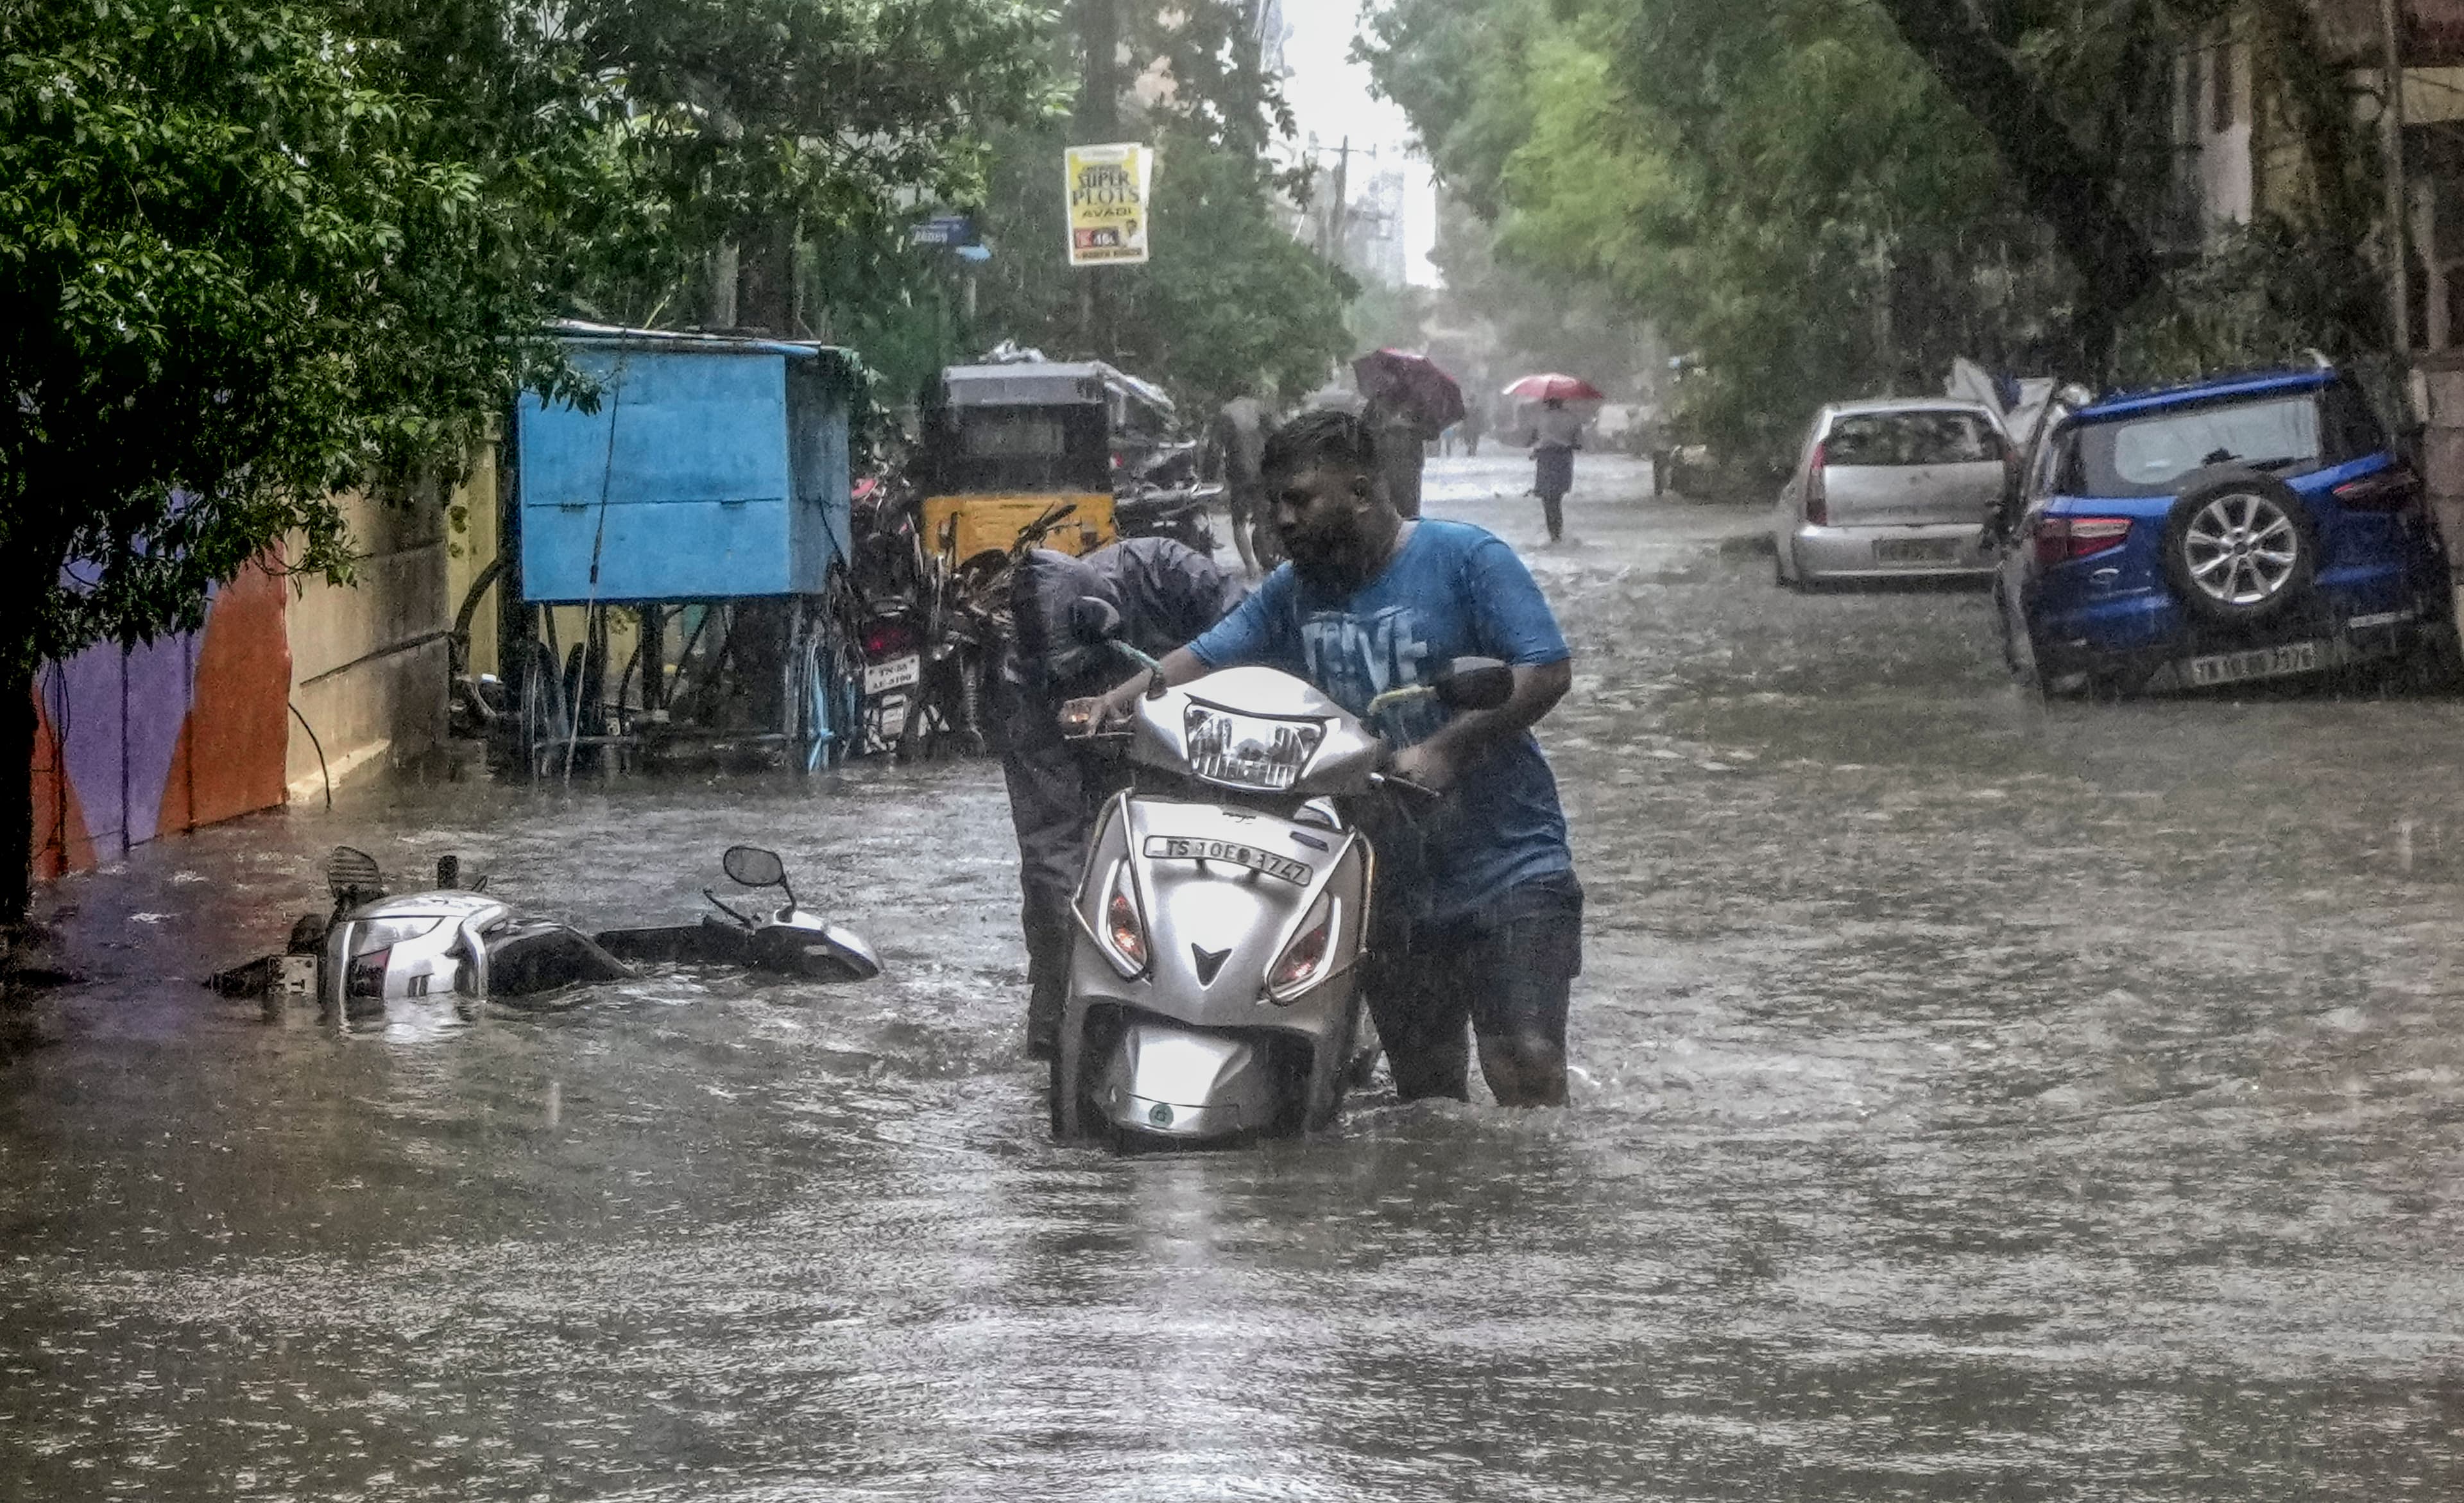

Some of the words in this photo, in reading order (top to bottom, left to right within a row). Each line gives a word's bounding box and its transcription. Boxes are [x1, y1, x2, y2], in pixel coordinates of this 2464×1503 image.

[1077, 169, 1130, 187] SUPER
[1072, 187, 1140, 207] PLOTS
[1082, 207, 1133, 218] AVADI
